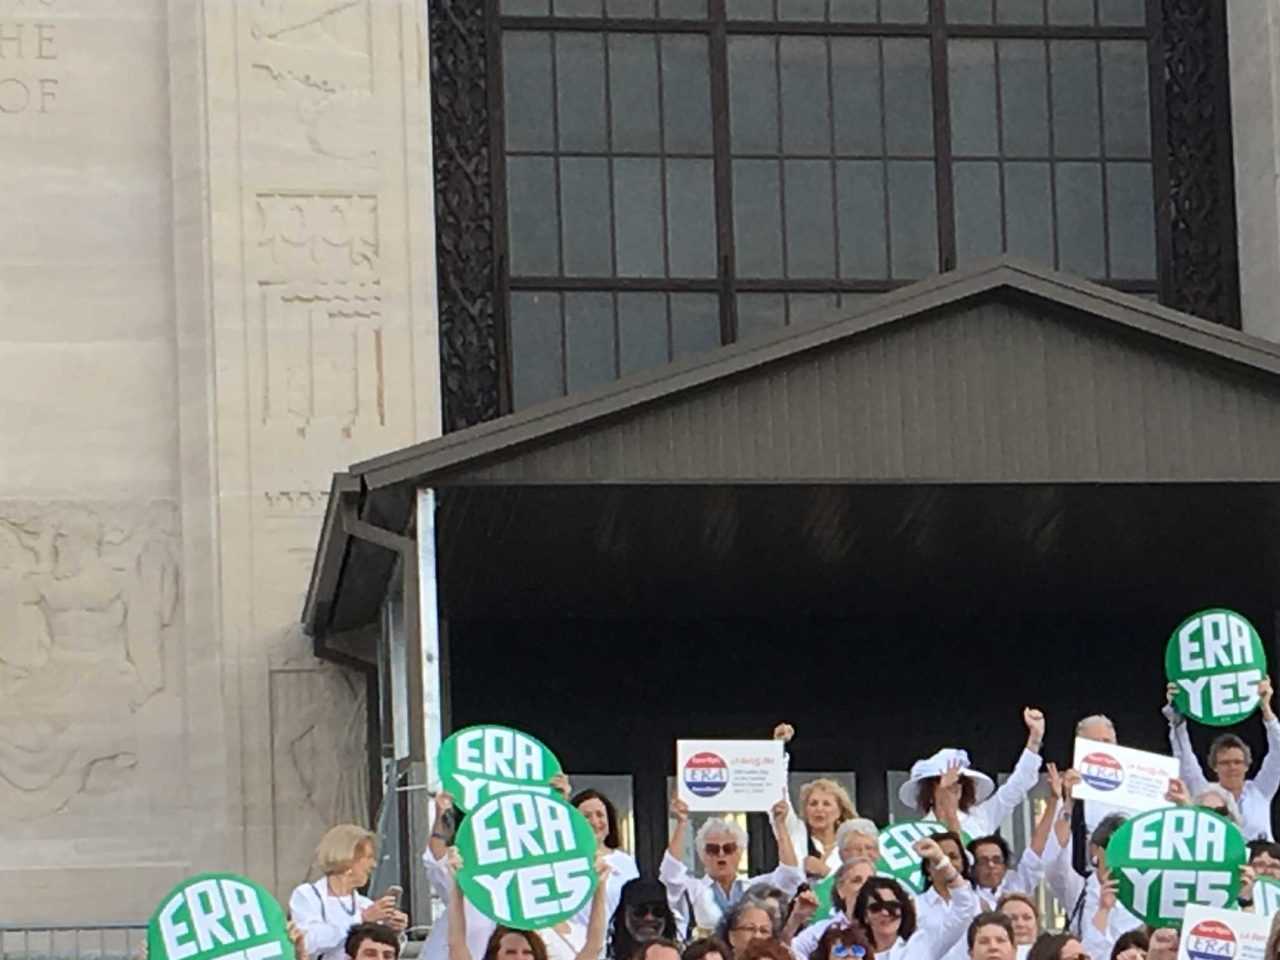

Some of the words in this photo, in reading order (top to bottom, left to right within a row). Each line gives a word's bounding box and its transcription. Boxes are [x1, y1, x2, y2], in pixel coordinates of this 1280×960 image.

[1178, 612, 1254, 671] ERA
[1176, 669, 1260, 716] YES
[456, 727, 543, 782] ERA
[470, 792, 576, 865] ERA
[1129, 809, 1226, 863] ERA
[473, 858, 591, 921] YES
[1121, 868, 1232, 920] YES
